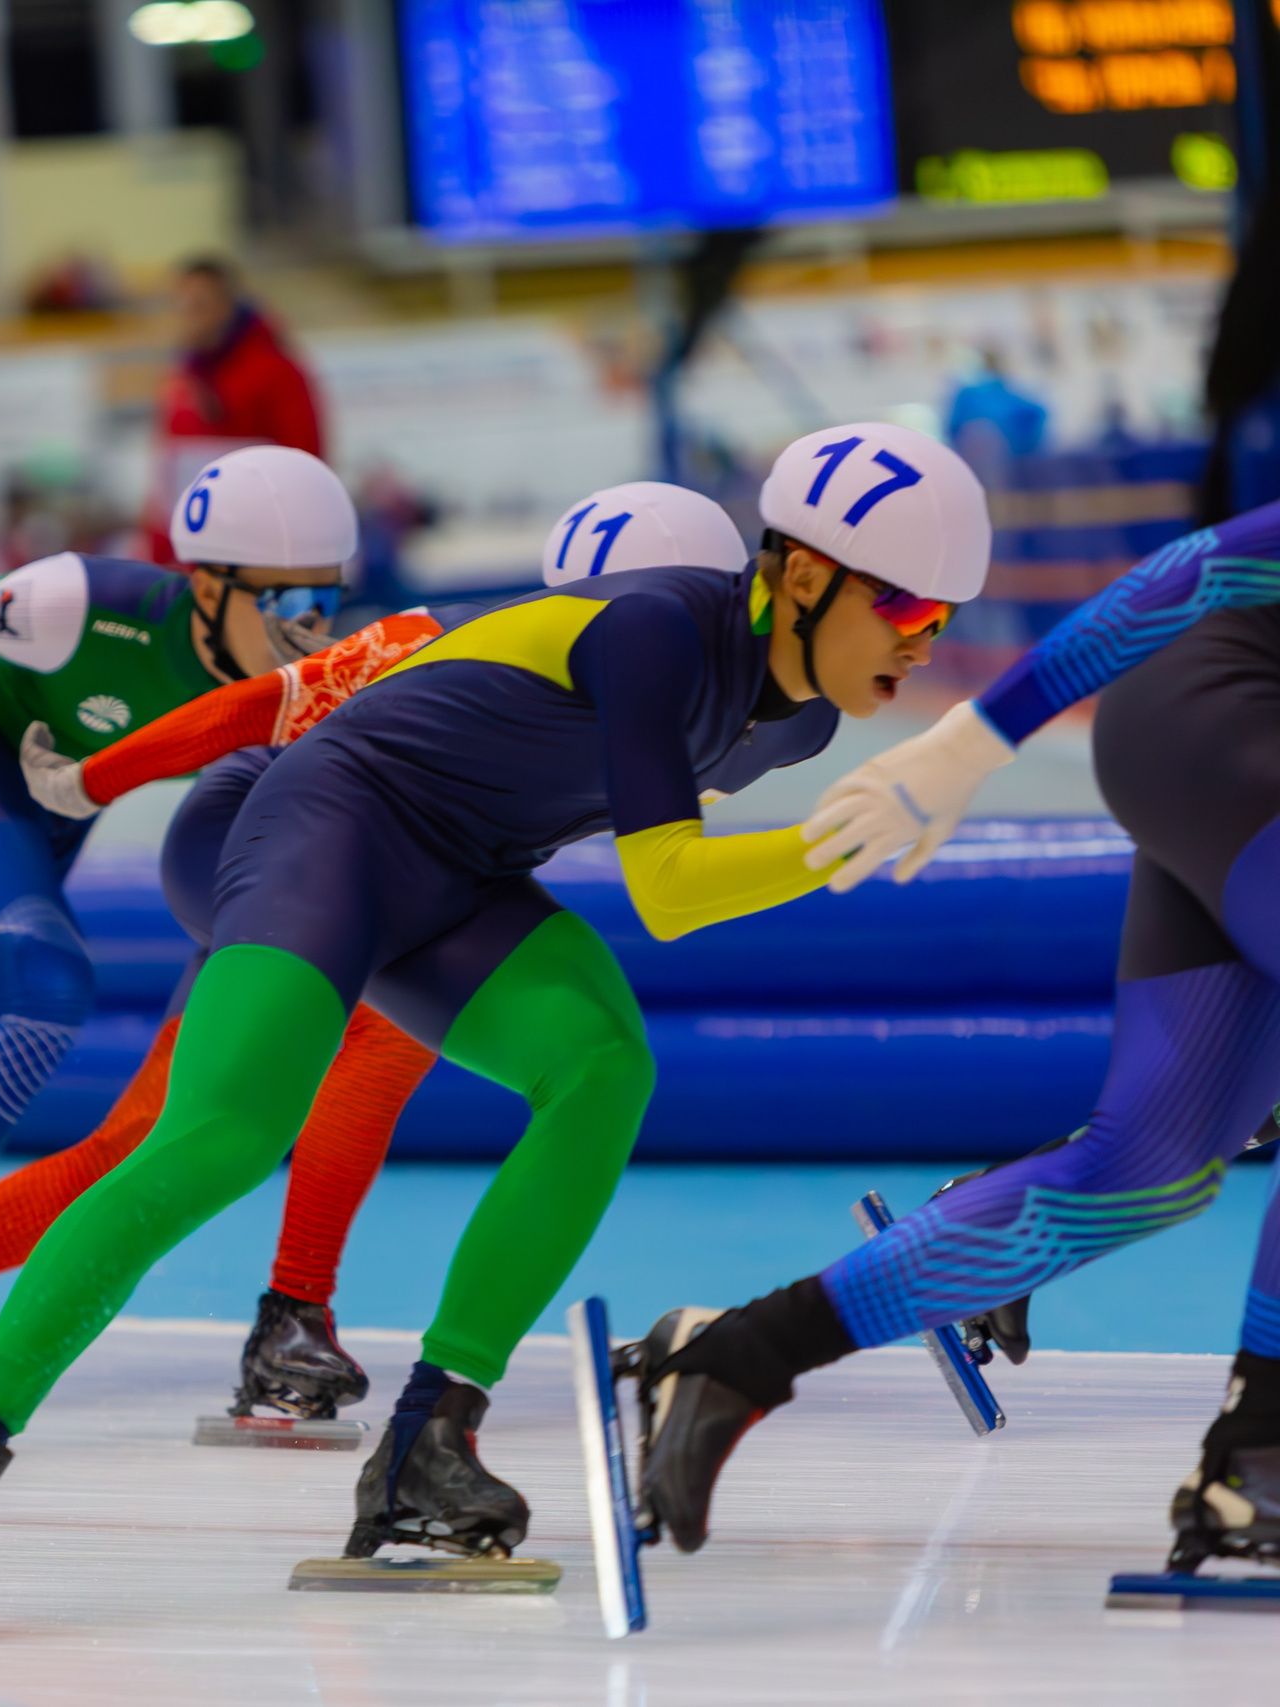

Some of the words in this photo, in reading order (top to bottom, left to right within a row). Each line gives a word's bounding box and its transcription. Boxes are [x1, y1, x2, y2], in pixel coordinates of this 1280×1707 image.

[185, 468, 220, 533] 6
[805, 436, 923, 528] 17
[556, 502, 634, 577] 11
